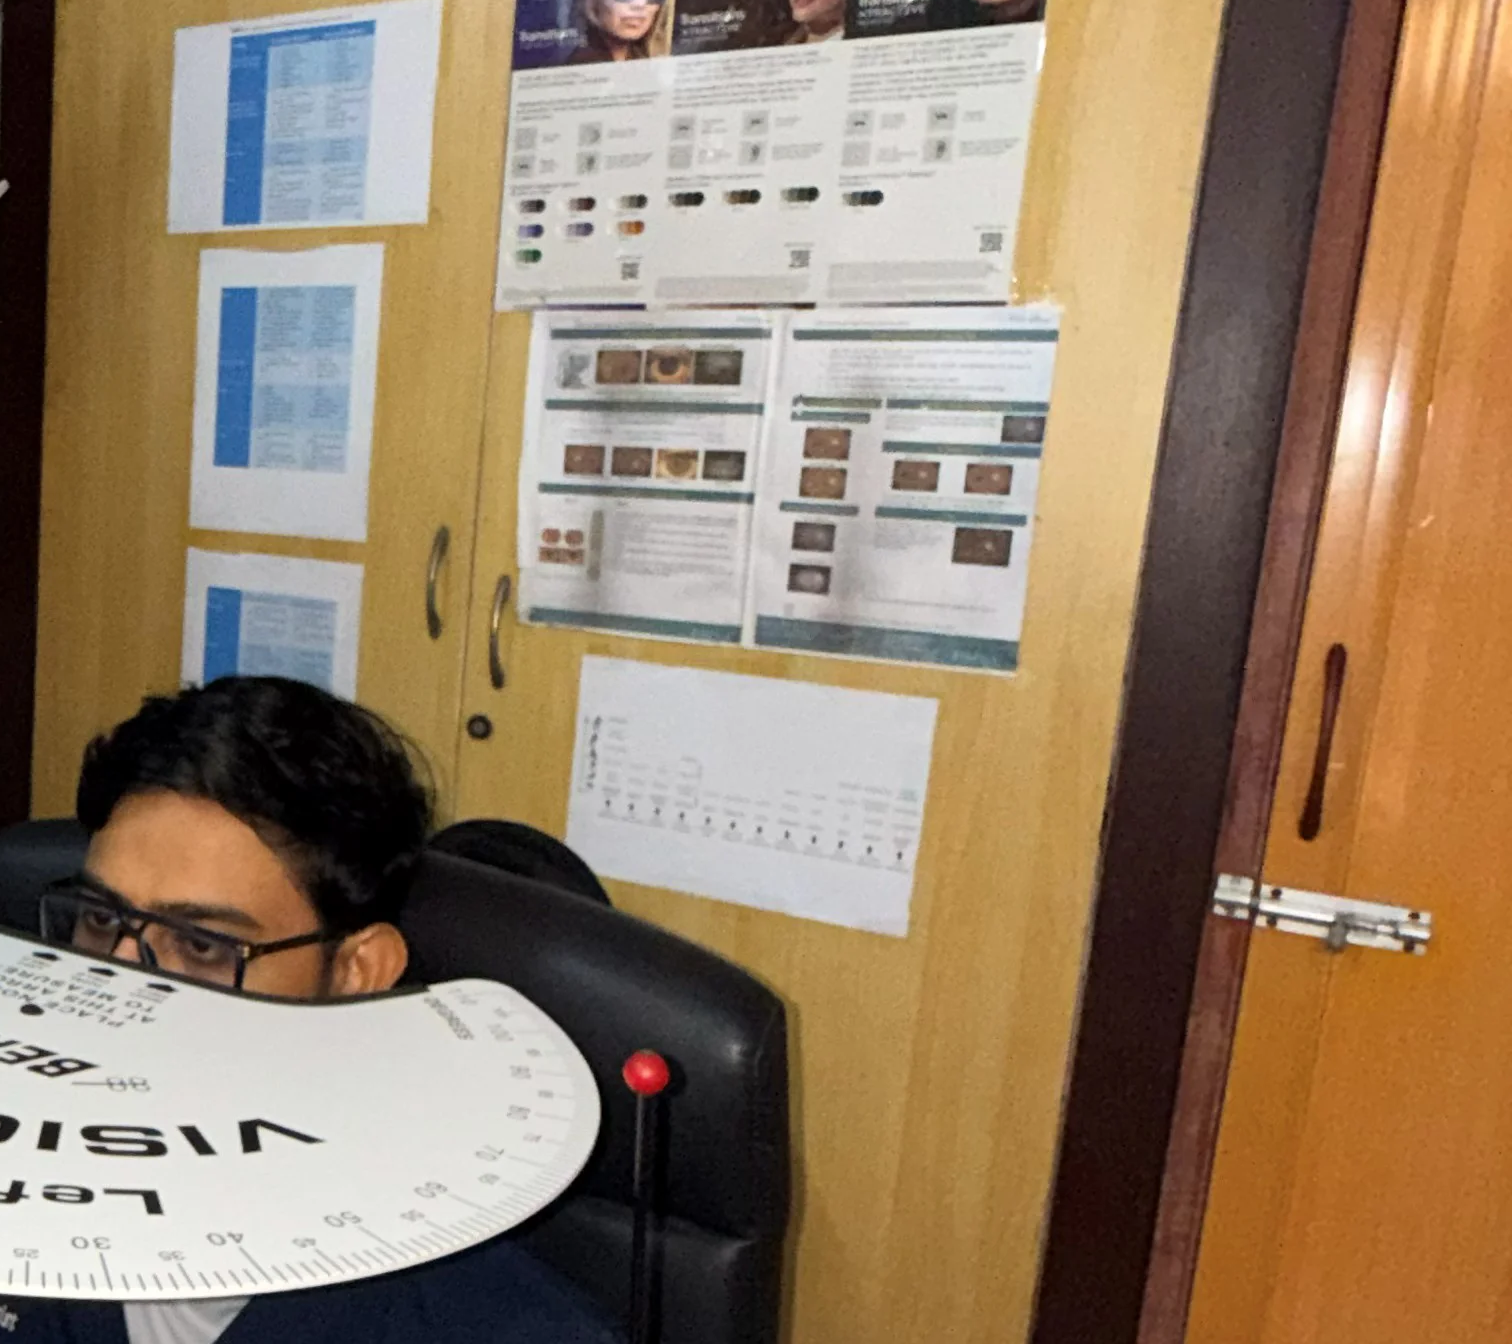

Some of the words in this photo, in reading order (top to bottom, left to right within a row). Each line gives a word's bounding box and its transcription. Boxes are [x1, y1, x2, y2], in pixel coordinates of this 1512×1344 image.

[323, 1210, 363, 1229] 50
[70, 1235, 112, 1251] 30
[206, 1231, 245, 1247] 40
